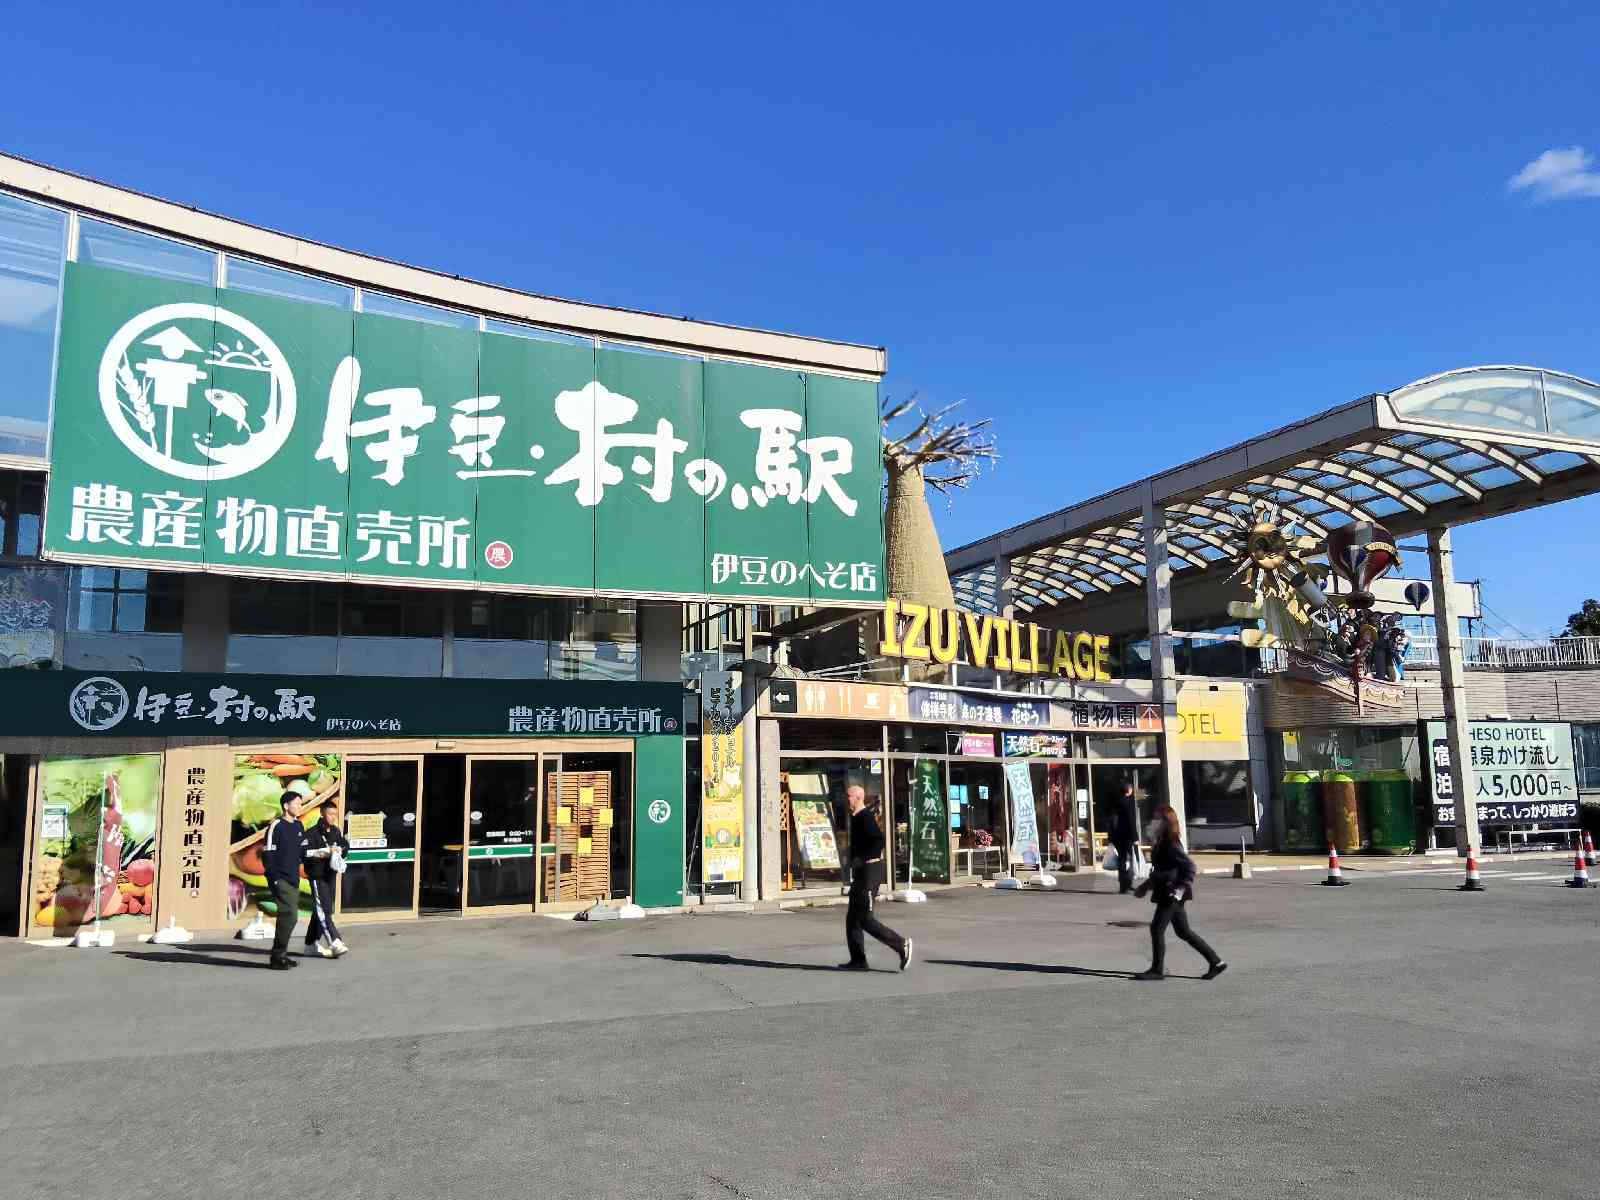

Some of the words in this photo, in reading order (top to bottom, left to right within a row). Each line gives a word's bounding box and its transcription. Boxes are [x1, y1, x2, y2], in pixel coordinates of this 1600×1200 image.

[315, 355, 858, 517] 伊豆・村の駅
[66, 483, 471, 570] 農産物直売所
[711, 553, 877, 593] 伊豆のへそ店
[880, 599, 958, 665] IZU
[961, 613, 1112, 683] VILLAGE
[134, 685, 316, 725] 伊豆・村の駅
[326, 717, 402, 732] 伊豆のへそ店
[508, 705, 662, 734] 農産物直売所
[1072, 702, 1138, 729] 植物園
[1006, 735, 1041, 754] 天然石
[1506, 727, 1546, 741] HOTEL
[1434, 745, 1454, 795] 宿泊
[919, 774, 938, 841] 天然石
[1010, 767, 1035, 842] 天然石
[181, 767, 207, 890] 農産物直売所
